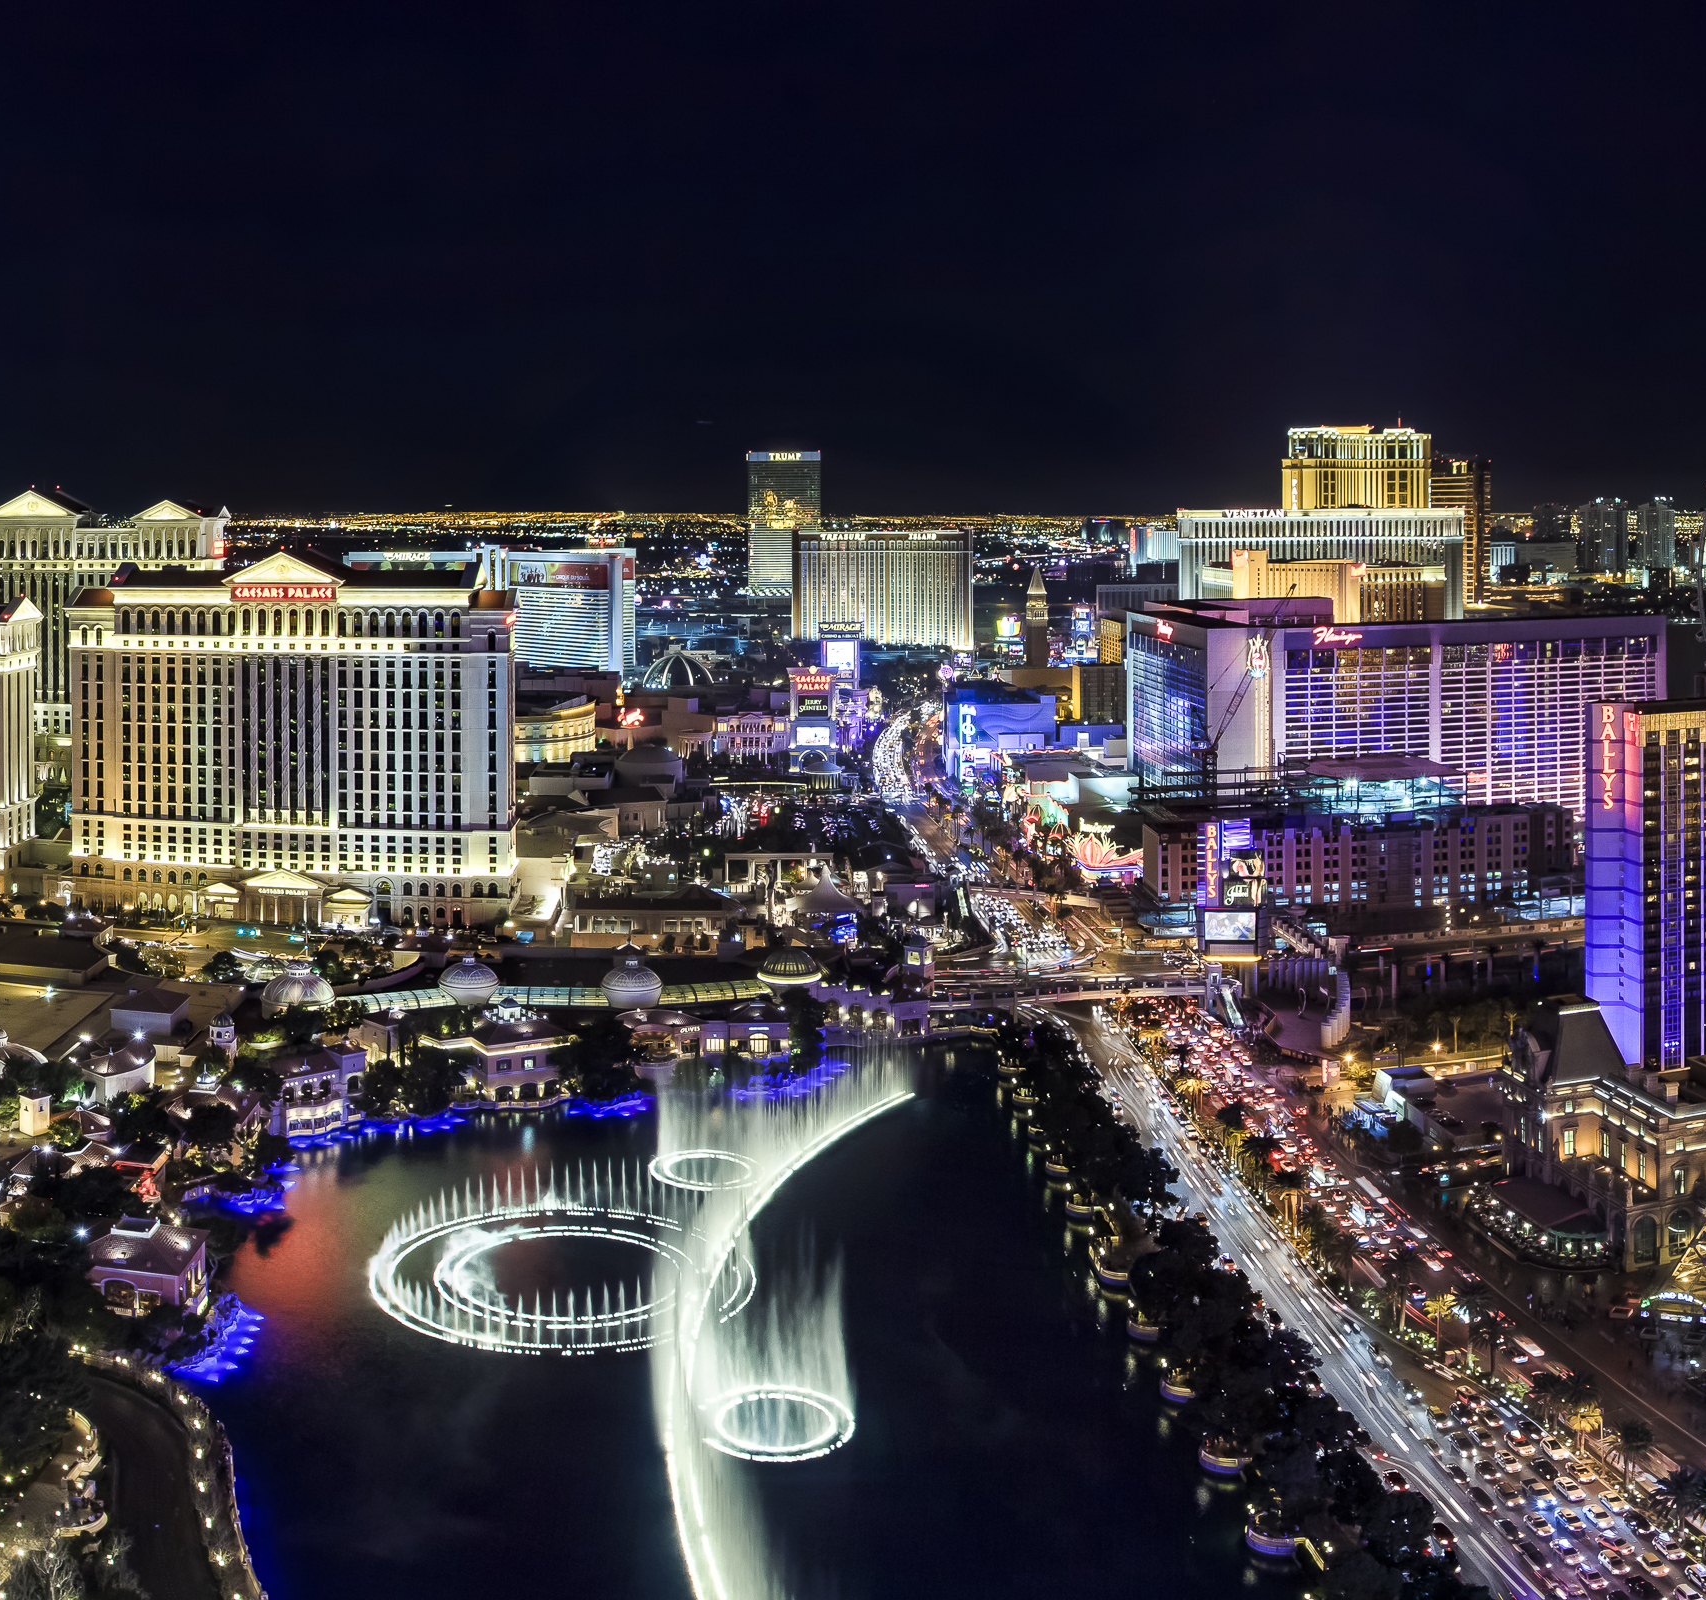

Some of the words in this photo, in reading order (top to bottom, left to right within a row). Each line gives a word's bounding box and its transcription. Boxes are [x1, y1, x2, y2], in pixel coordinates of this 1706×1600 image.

[768, 453, 801, 461] TRUMP
[1225, 509, 1285, 518] VENETIAN
[820, 533, 866, 541] TREASURE
[908, 533, 937, 541] ISLAND
[392, 552, 431, 562] MIRAGE
[234, 587, 284, 598] CAESARS
[288, 587, 333, 598] PALACE
[828, 623, 861, 631] MIRAGE
[1312, 626, 1363, 645] Flamingo
[795, 675, 831, 683] CAESARS
[1599, 705, 1617, 810] BALLYS
[1206, 825, 1218, 898] BALLYS
